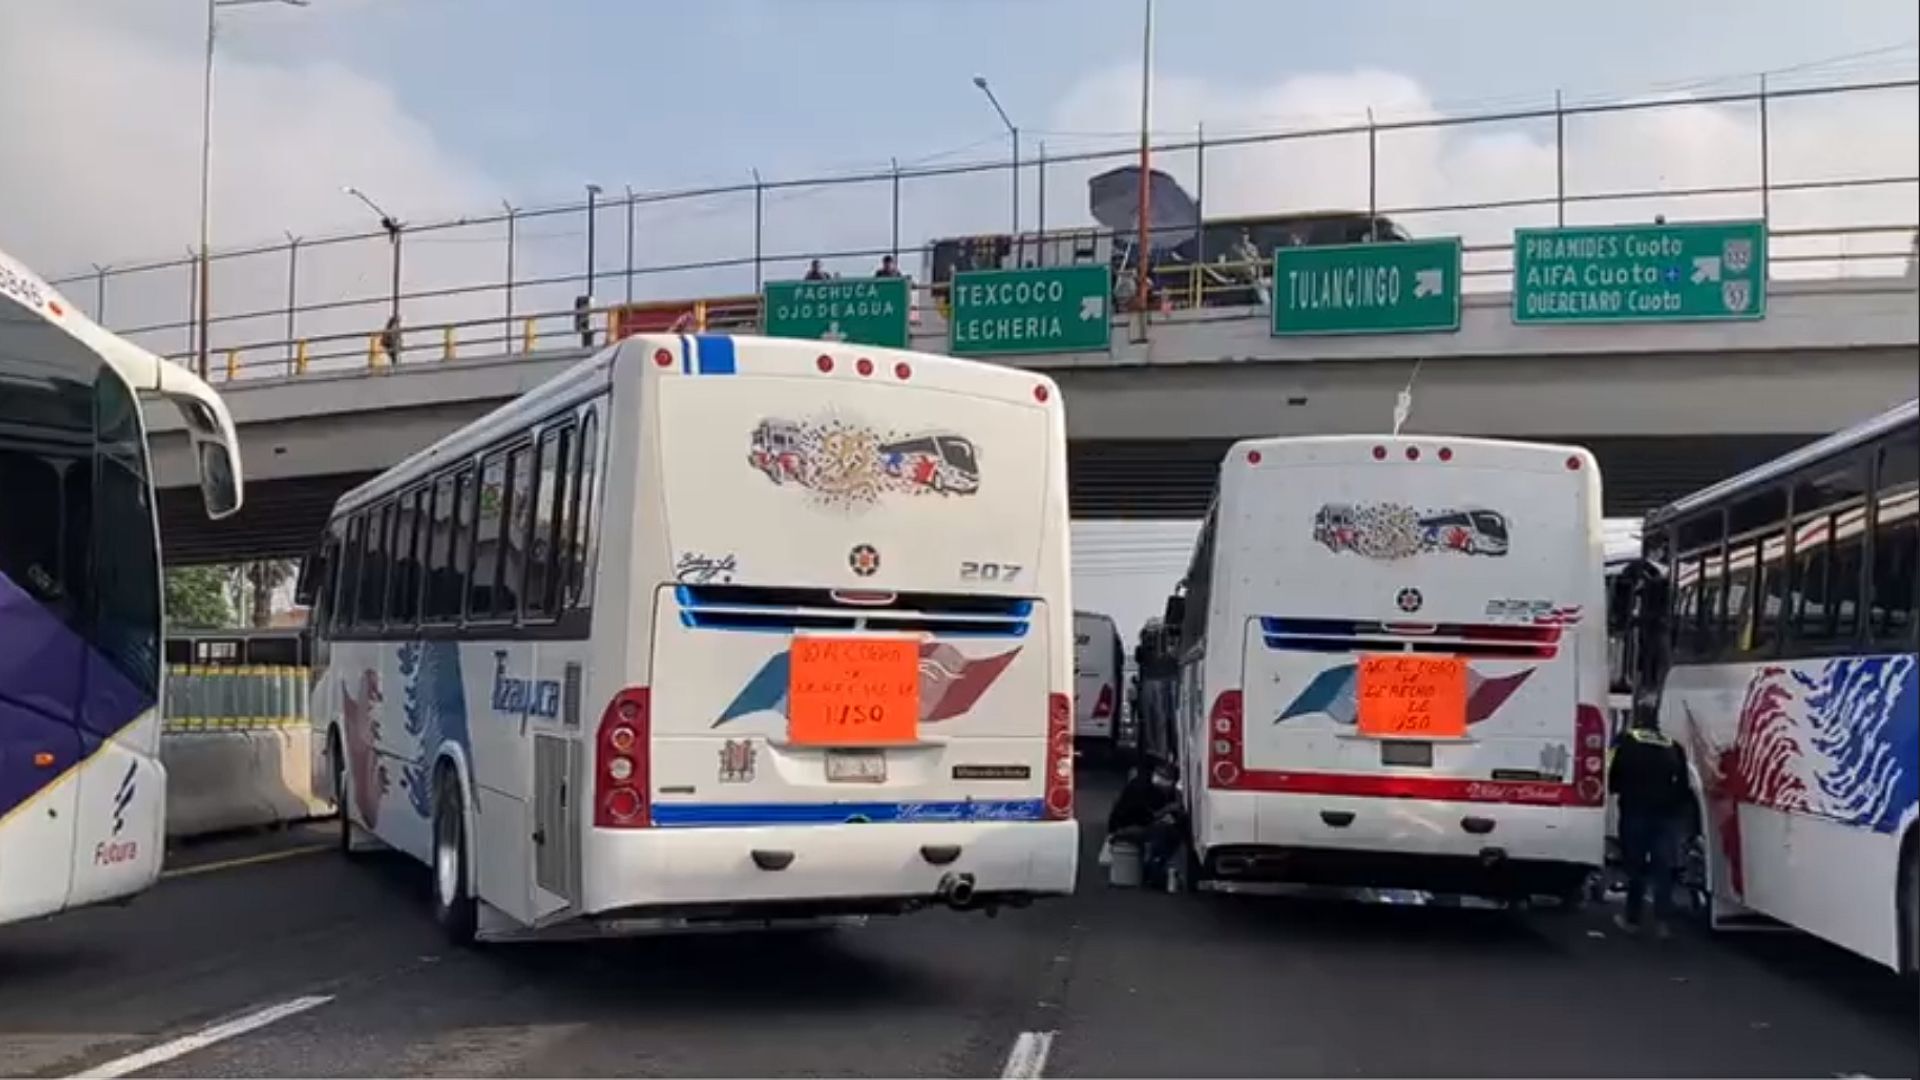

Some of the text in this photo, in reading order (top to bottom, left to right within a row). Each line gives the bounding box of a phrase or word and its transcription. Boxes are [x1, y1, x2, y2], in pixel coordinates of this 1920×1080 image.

[1625, 234, 1683, 258] Cuota
[1526, 262, 1658, 287] AIFA Cuota
[794, 283, 879, 301] PACHUCA
[957, 281, 1063, 307] TEXCOCO
[1289, 265, 1400, 310] TULANCINGO
[777, 301, 894, 320] OJO DE AGUA
[1628, 289, 1682, 312] Cuota
[956, 316, 1063, 342] LECHERIA
[959, 561, 1023, 584] 207
[95, 841, 137, 866] Futura
